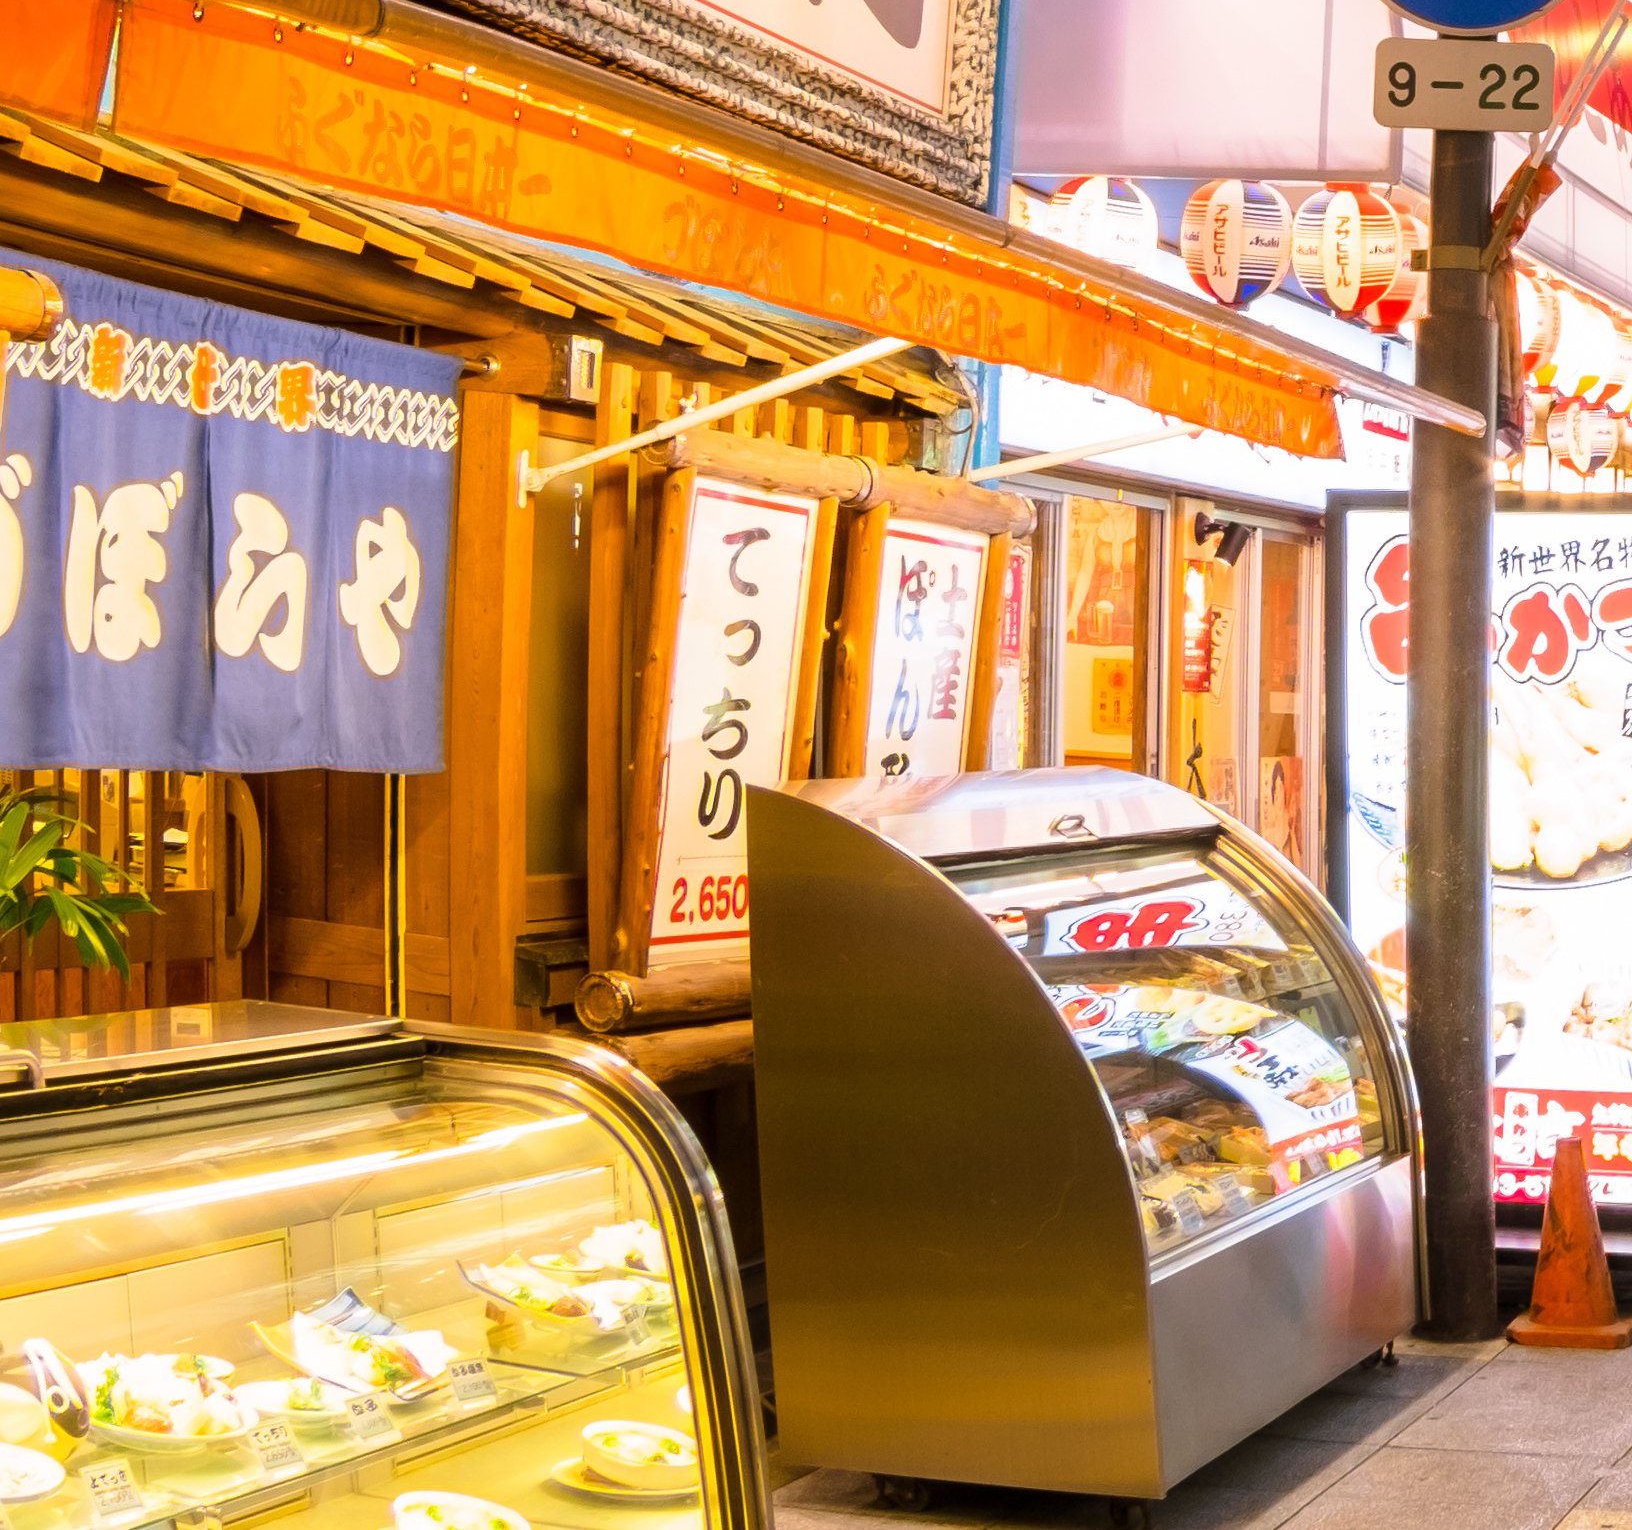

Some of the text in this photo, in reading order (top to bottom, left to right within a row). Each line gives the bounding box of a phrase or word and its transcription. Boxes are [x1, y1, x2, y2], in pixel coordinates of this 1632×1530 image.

[1212, 203, 1229, 278] アサヒビール
[1248, 233, 1281, 249] Asahi
[1334, 215, 1352, 289] アサヒビール
[696, 524, 773, 843] てっちり
[669, 872, 748, 926] 2,650
